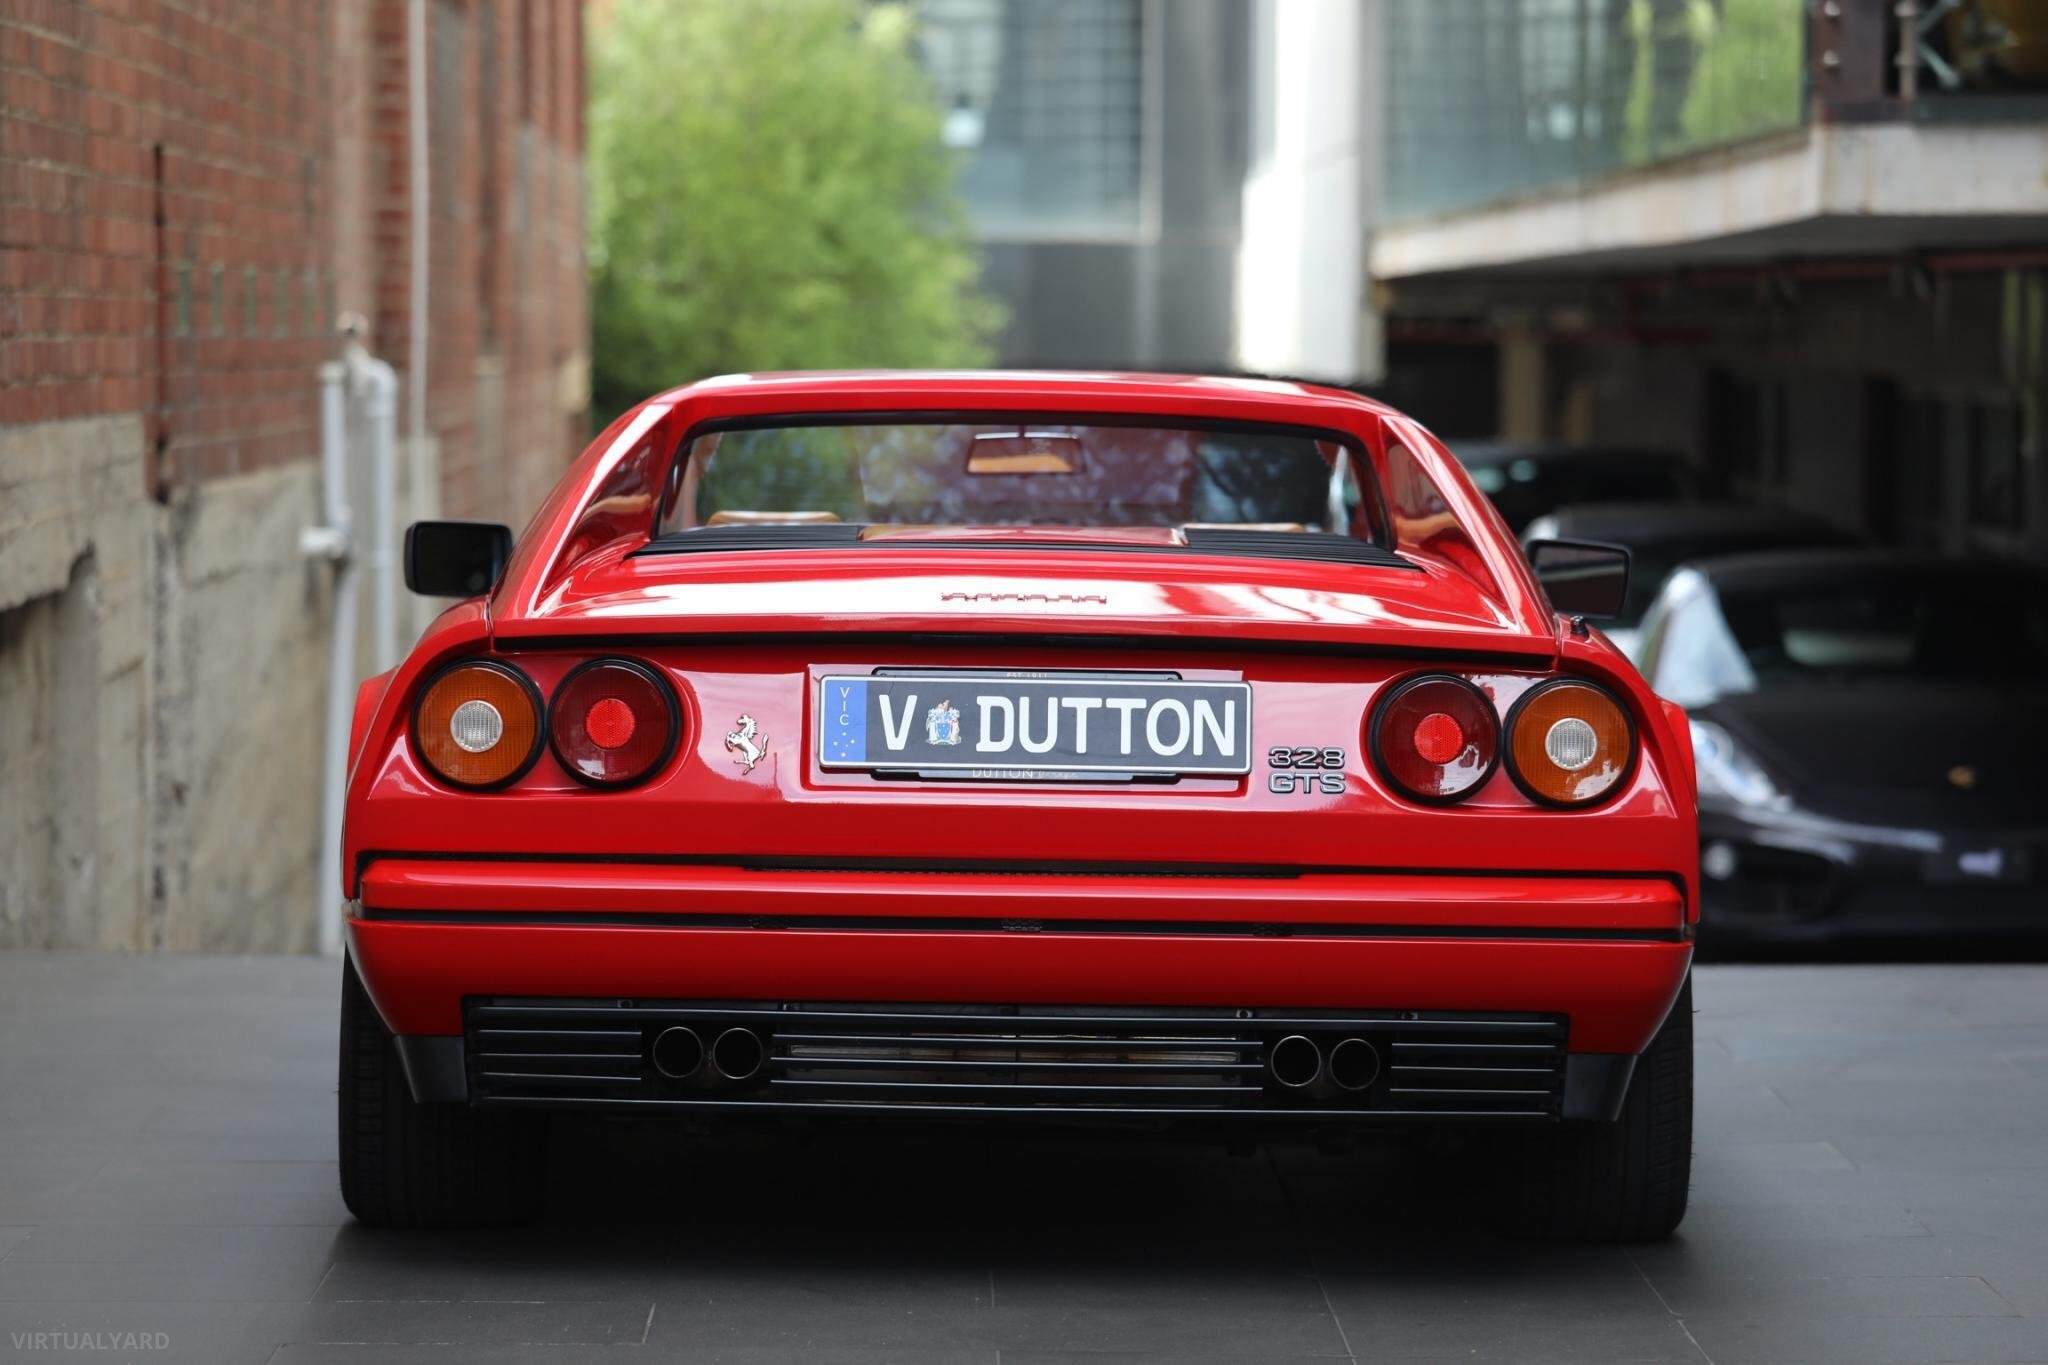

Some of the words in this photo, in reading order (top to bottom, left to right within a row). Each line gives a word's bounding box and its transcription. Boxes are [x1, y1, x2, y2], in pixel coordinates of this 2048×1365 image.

[839, 686, 851, 726] VIC
[878, 694, 918, 751] V
[975, 695, 1236, 757] DUTTON
[1268, 747, 1345, 769] 328
[1268, 771, 1346, 794] GTS
